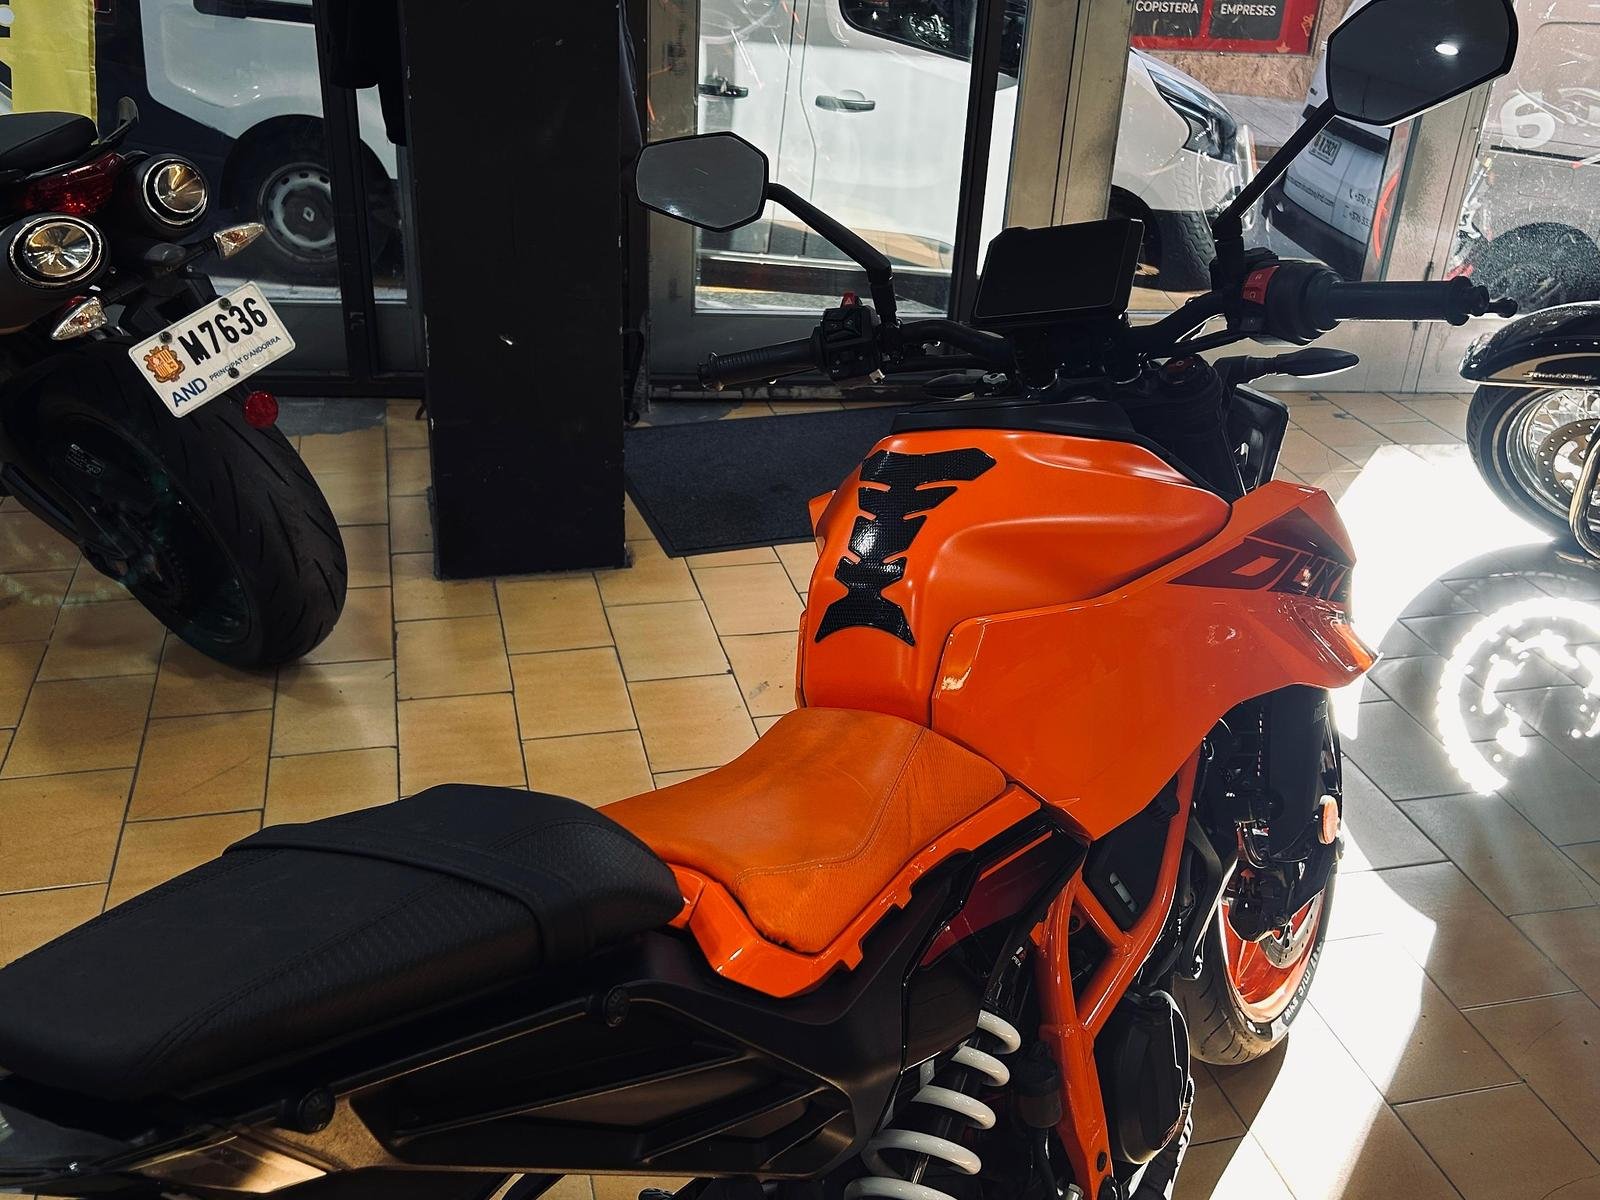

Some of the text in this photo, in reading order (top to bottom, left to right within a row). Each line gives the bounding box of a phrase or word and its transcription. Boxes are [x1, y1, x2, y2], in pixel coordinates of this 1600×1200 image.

[1220, 3, 1277, 16] EMPRESES
[177, 297, 268, 366] M7636
[208, 335, 281, 382] PRINCIPAT D'ANDORRA
[171, 377, 208, 407] AND
